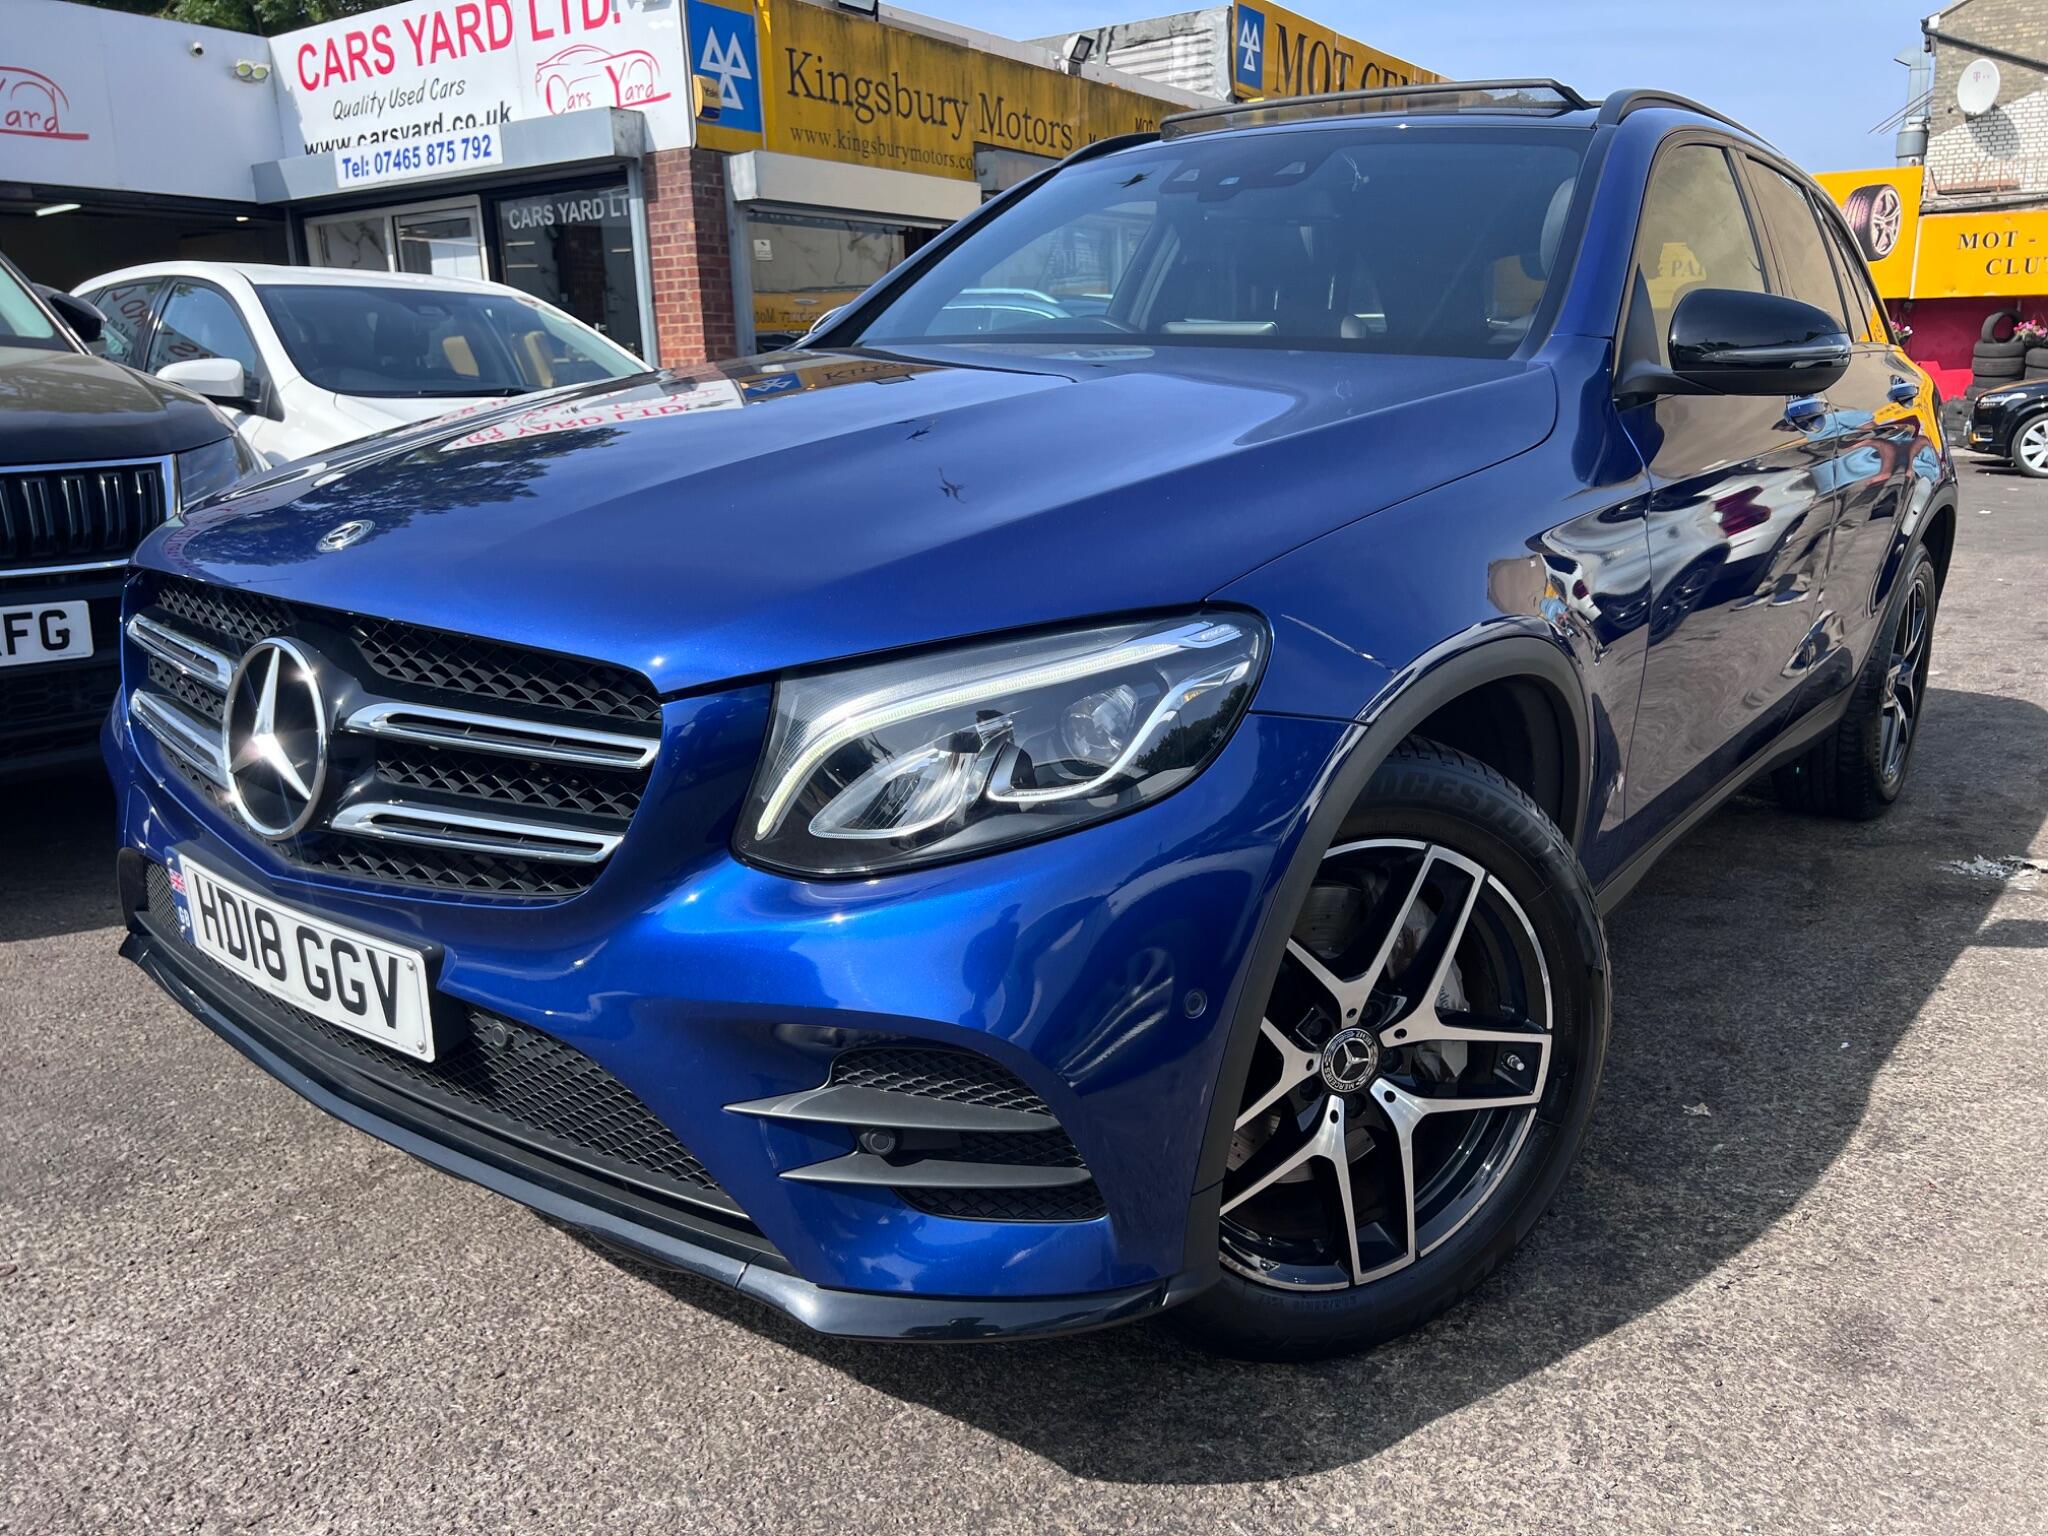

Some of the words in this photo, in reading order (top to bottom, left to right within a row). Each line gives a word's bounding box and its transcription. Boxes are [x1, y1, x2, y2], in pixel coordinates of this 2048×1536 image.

[297, 24, 395, 91] CARS
[402, 0, 513, 66] YARD
[1273, 23, 1354, 97] MOT
[0, 78, 60, 133] ard
[333, 90, 386, 120] Quality
[389, 79, 427, 109] Used
[430, 77, 466, 101] Cars
[545, 74, 592, 115] Cars
[784, 47, 970, 141] Kingsbury
[978, 92, 1073, 151] Motors
[342, 155, 370, 179] Tel:
[374, 146, 421, 175] 07465
[426, 140, 456, 166] 875
[461, 134, 492, 161] 792
[508, 204, 555, 230] CARS
[557, 198, 605, 223] YARD
[609, 191, 630, 217] LT
[1957, 230, 2019, 250] MOT
[0, 609, 71, 656] FG
[193, 872, 288, 983] HD18
[296, 924, 399, 1030] GGV
